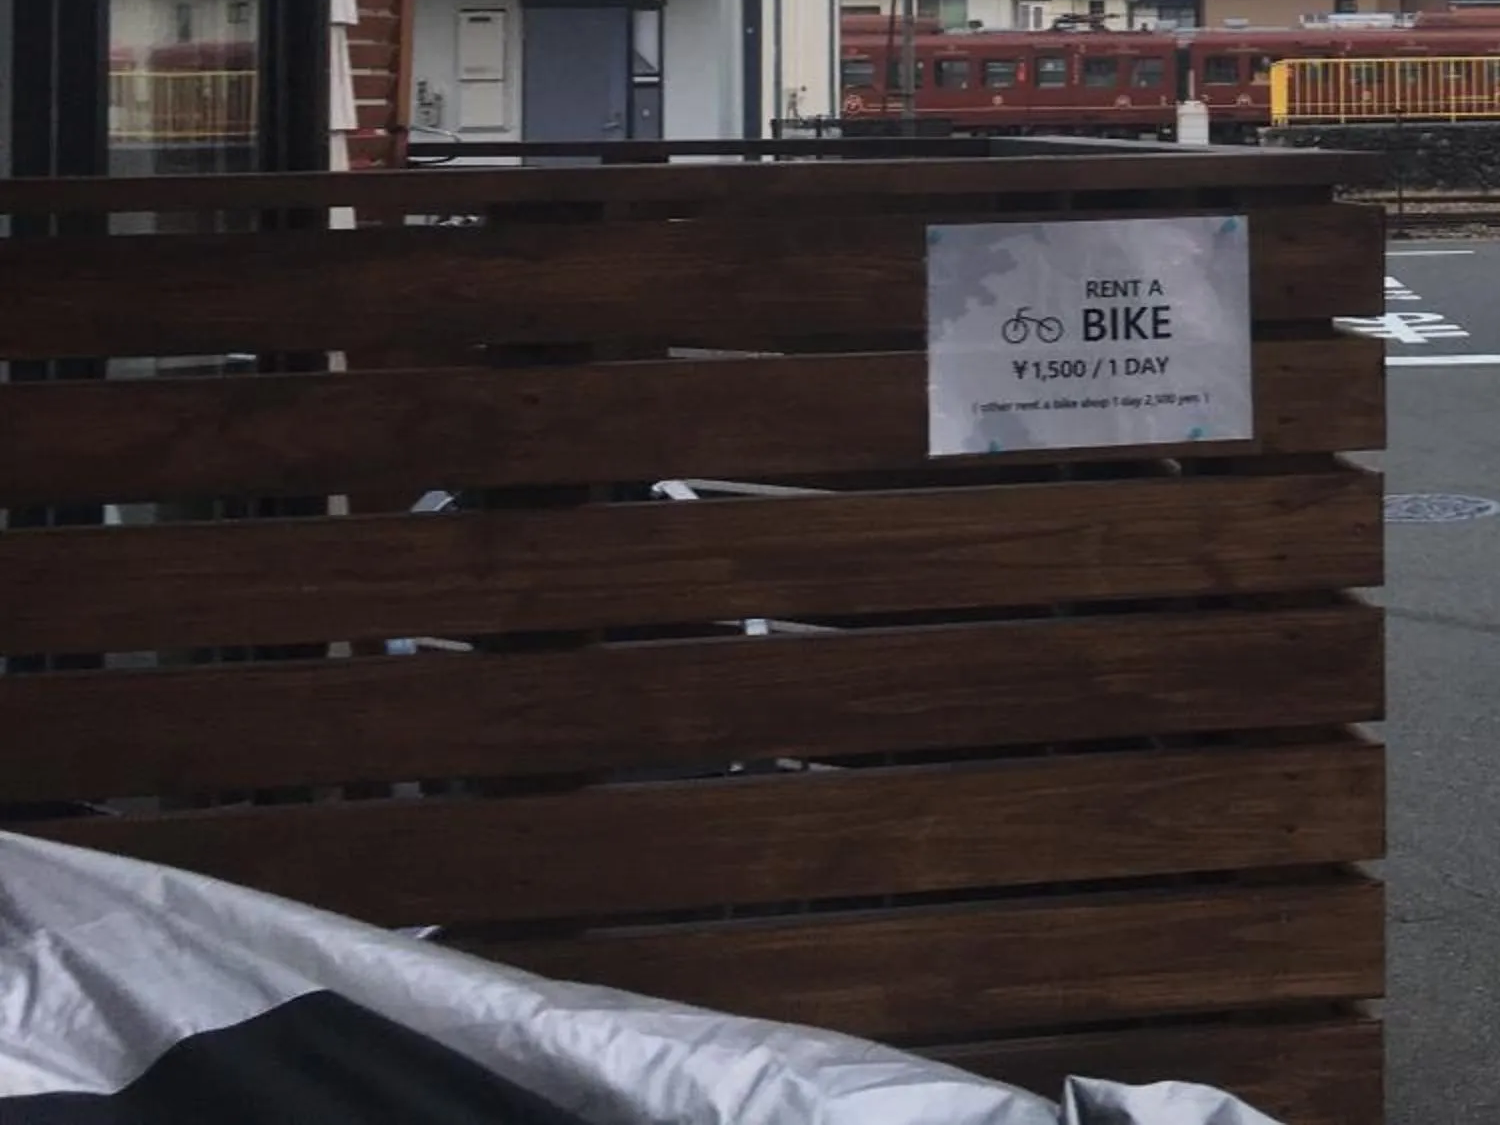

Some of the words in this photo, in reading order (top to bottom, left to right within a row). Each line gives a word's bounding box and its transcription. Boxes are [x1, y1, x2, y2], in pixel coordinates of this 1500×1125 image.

[1086, 279, 1142, 299] RENT
[1148, 278, 1164, 296] A
[1082, 305, 1172, 343] BIKE
[1125, 356, 1170, 375] DAY
